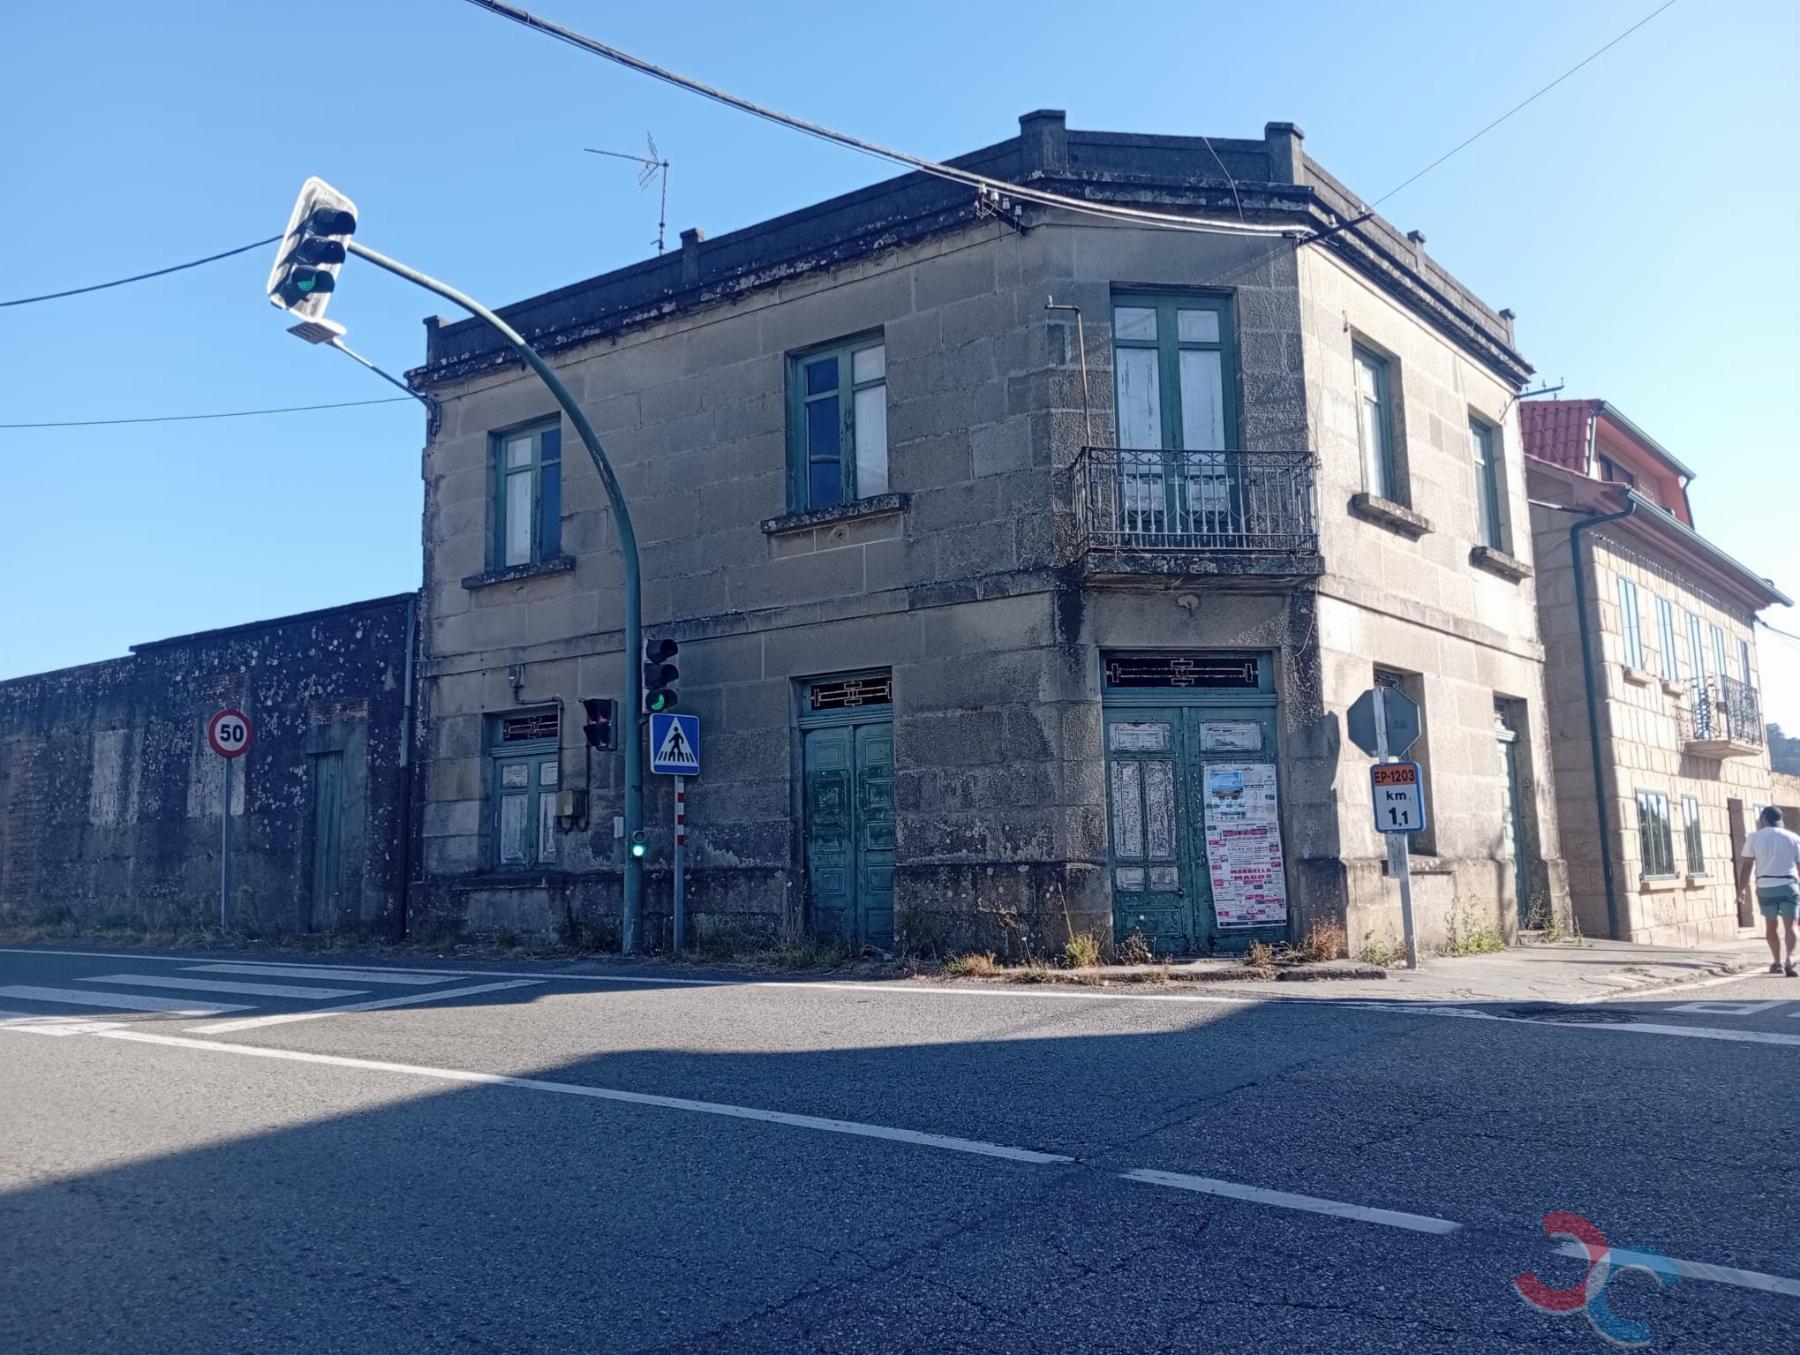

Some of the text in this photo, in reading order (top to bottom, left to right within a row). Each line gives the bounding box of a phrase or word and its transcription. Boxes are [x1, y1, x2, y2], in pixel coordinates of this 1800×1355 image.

[220, 724, 244, 742] 50
[1374, 769, 1415, 783] EP-1203
[1386, 791, 1407, 801] km
